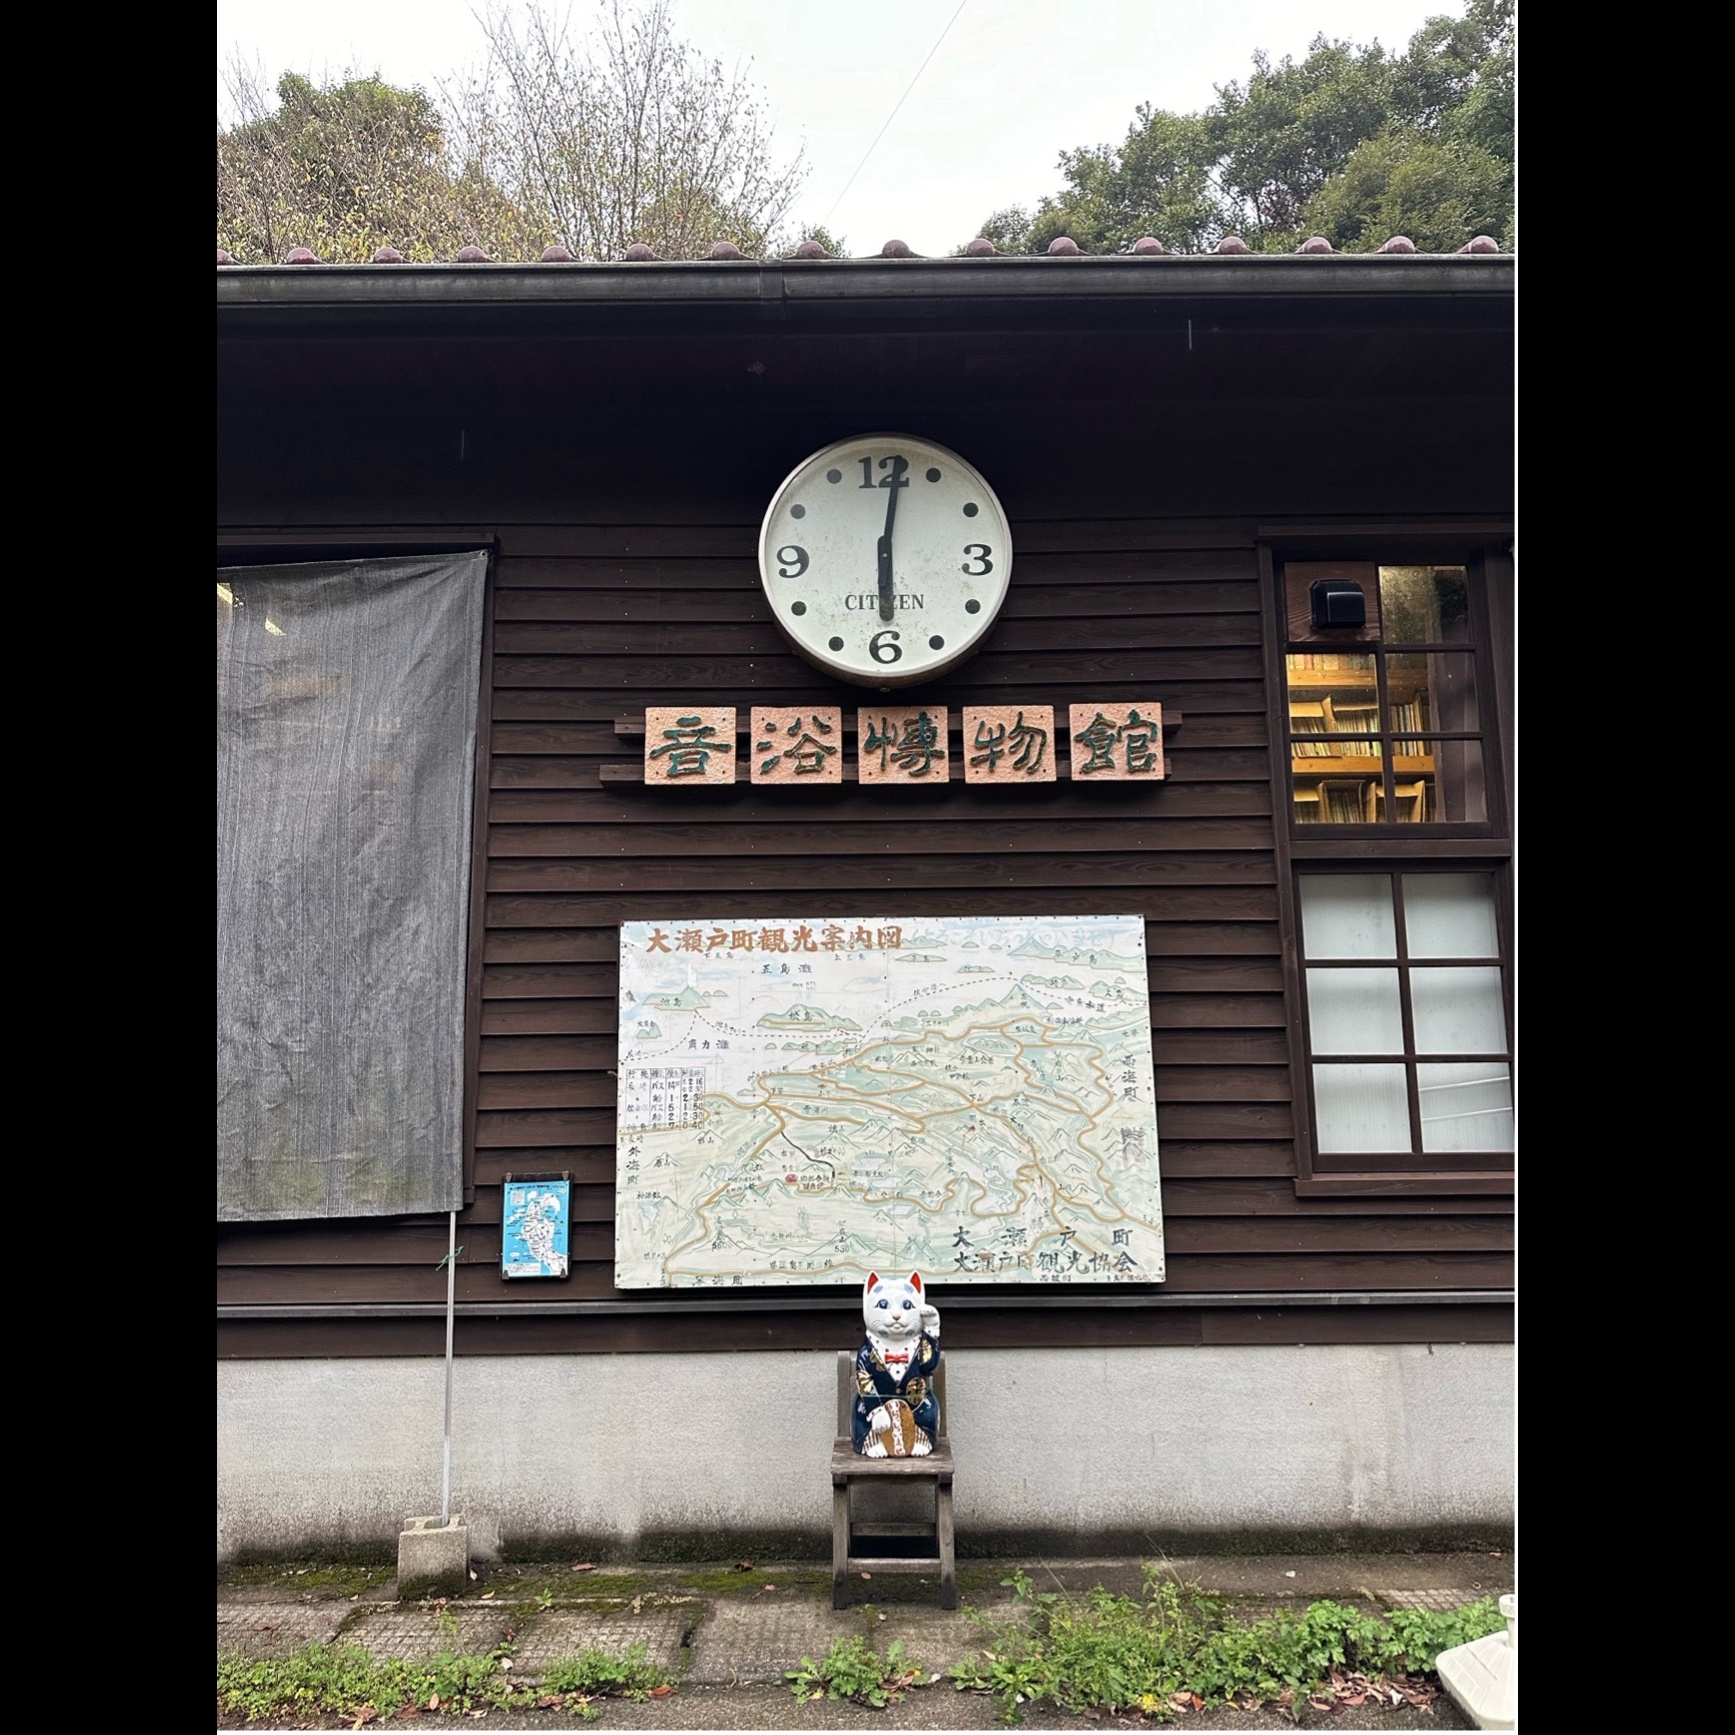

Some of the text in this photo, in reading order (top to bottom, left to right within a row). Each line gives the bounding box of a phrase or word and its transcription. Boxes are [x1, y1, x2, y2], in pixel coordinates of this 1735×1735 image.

[858, 456, 909, 488] 12
[776, 545, 810, 578] 9
[961, 543, 993, 576] 3
[845, 594, 924, 610] CITZEN
[869, 630, 902, 664] 6
[952, 1226, 1133, 1247] 大瀬戸町
